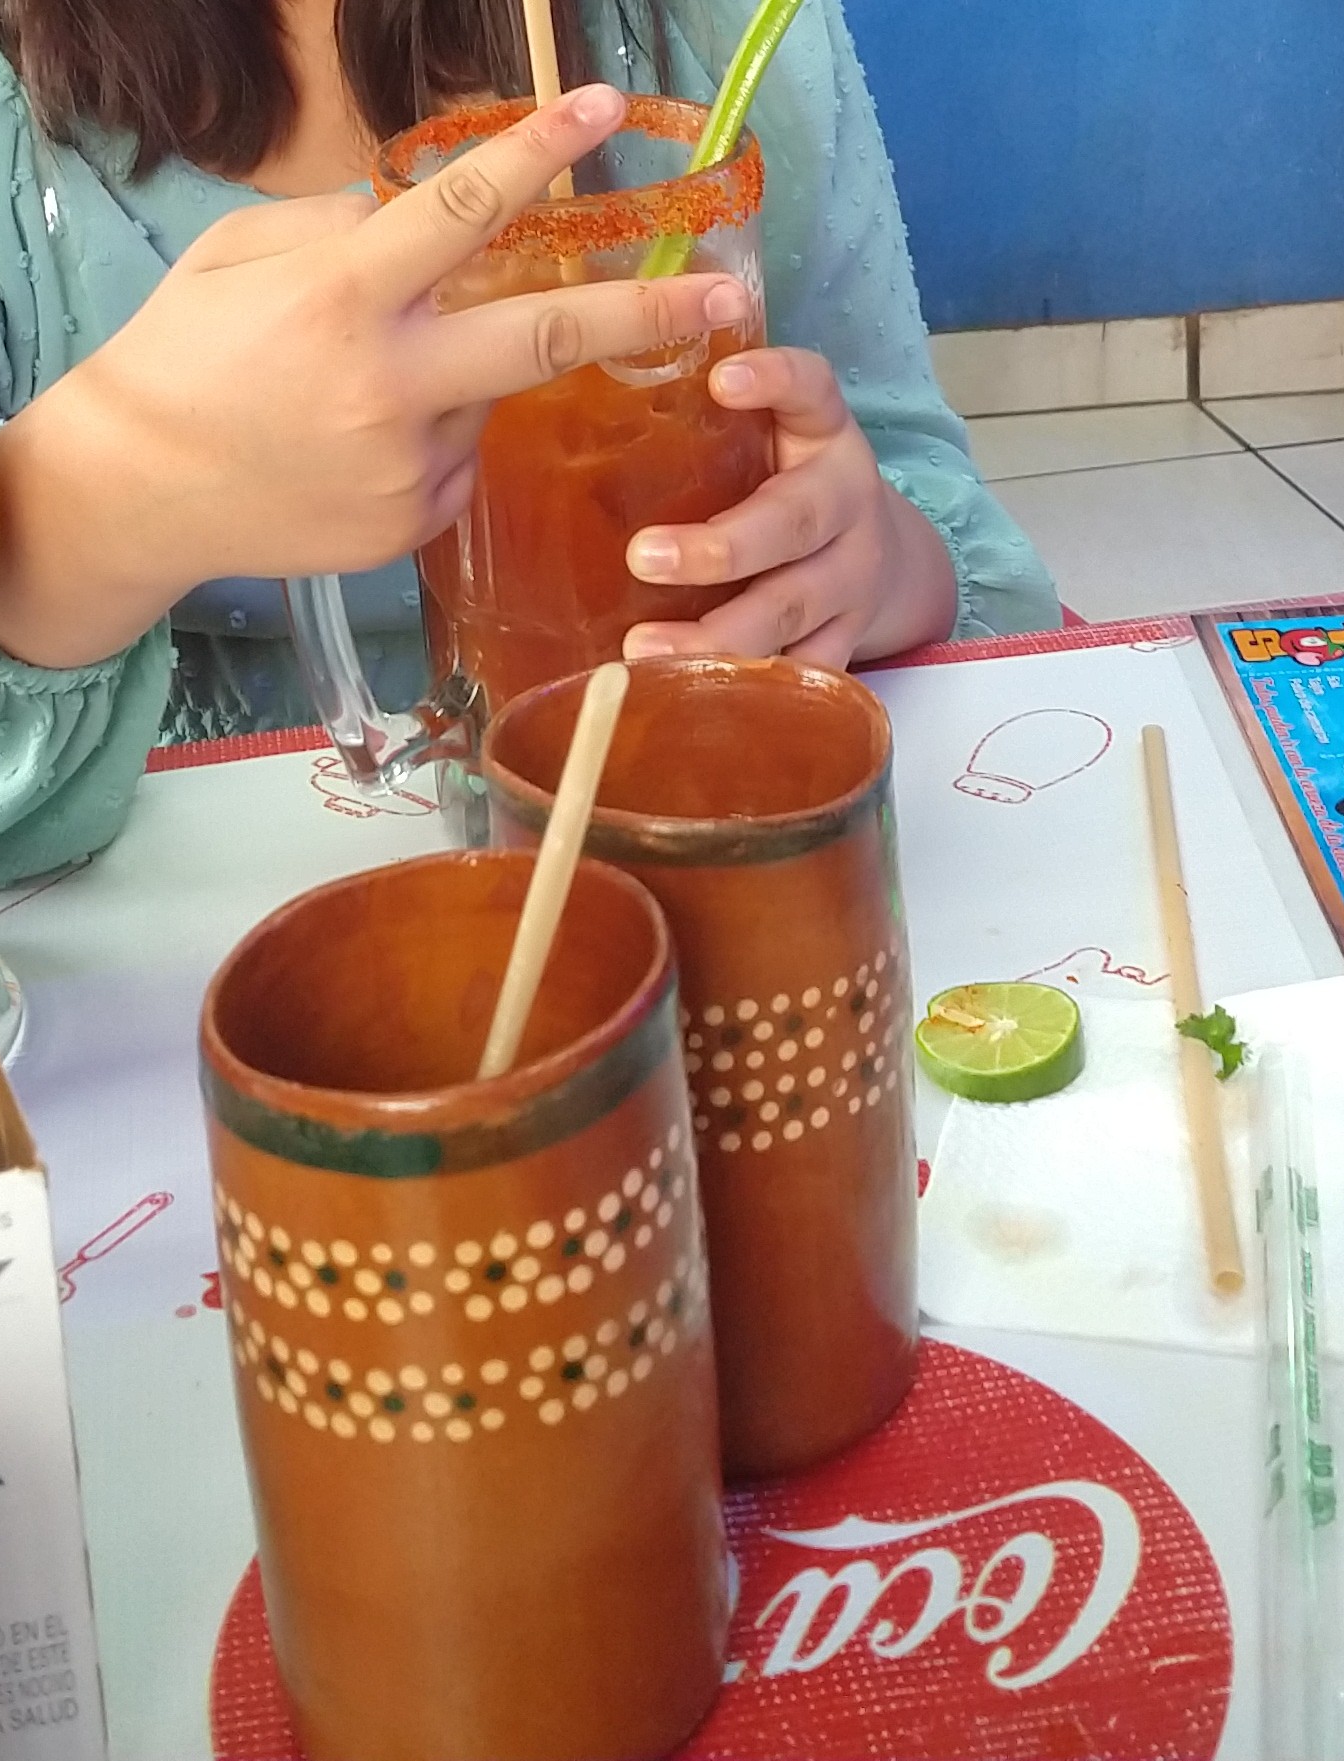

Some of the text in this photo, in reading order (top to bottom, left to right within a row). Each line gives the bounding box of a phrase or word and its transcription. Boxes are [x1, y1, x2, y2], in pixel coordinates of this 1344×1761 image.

[10, 1619, 40, 1645] EN
[44, 1613, 69, 1639] EL
[0, 1650, 23, 1676] DE
[27, 1641, 71, 1670] ESTE
[10, 1697, 80, 1732] SALUD
